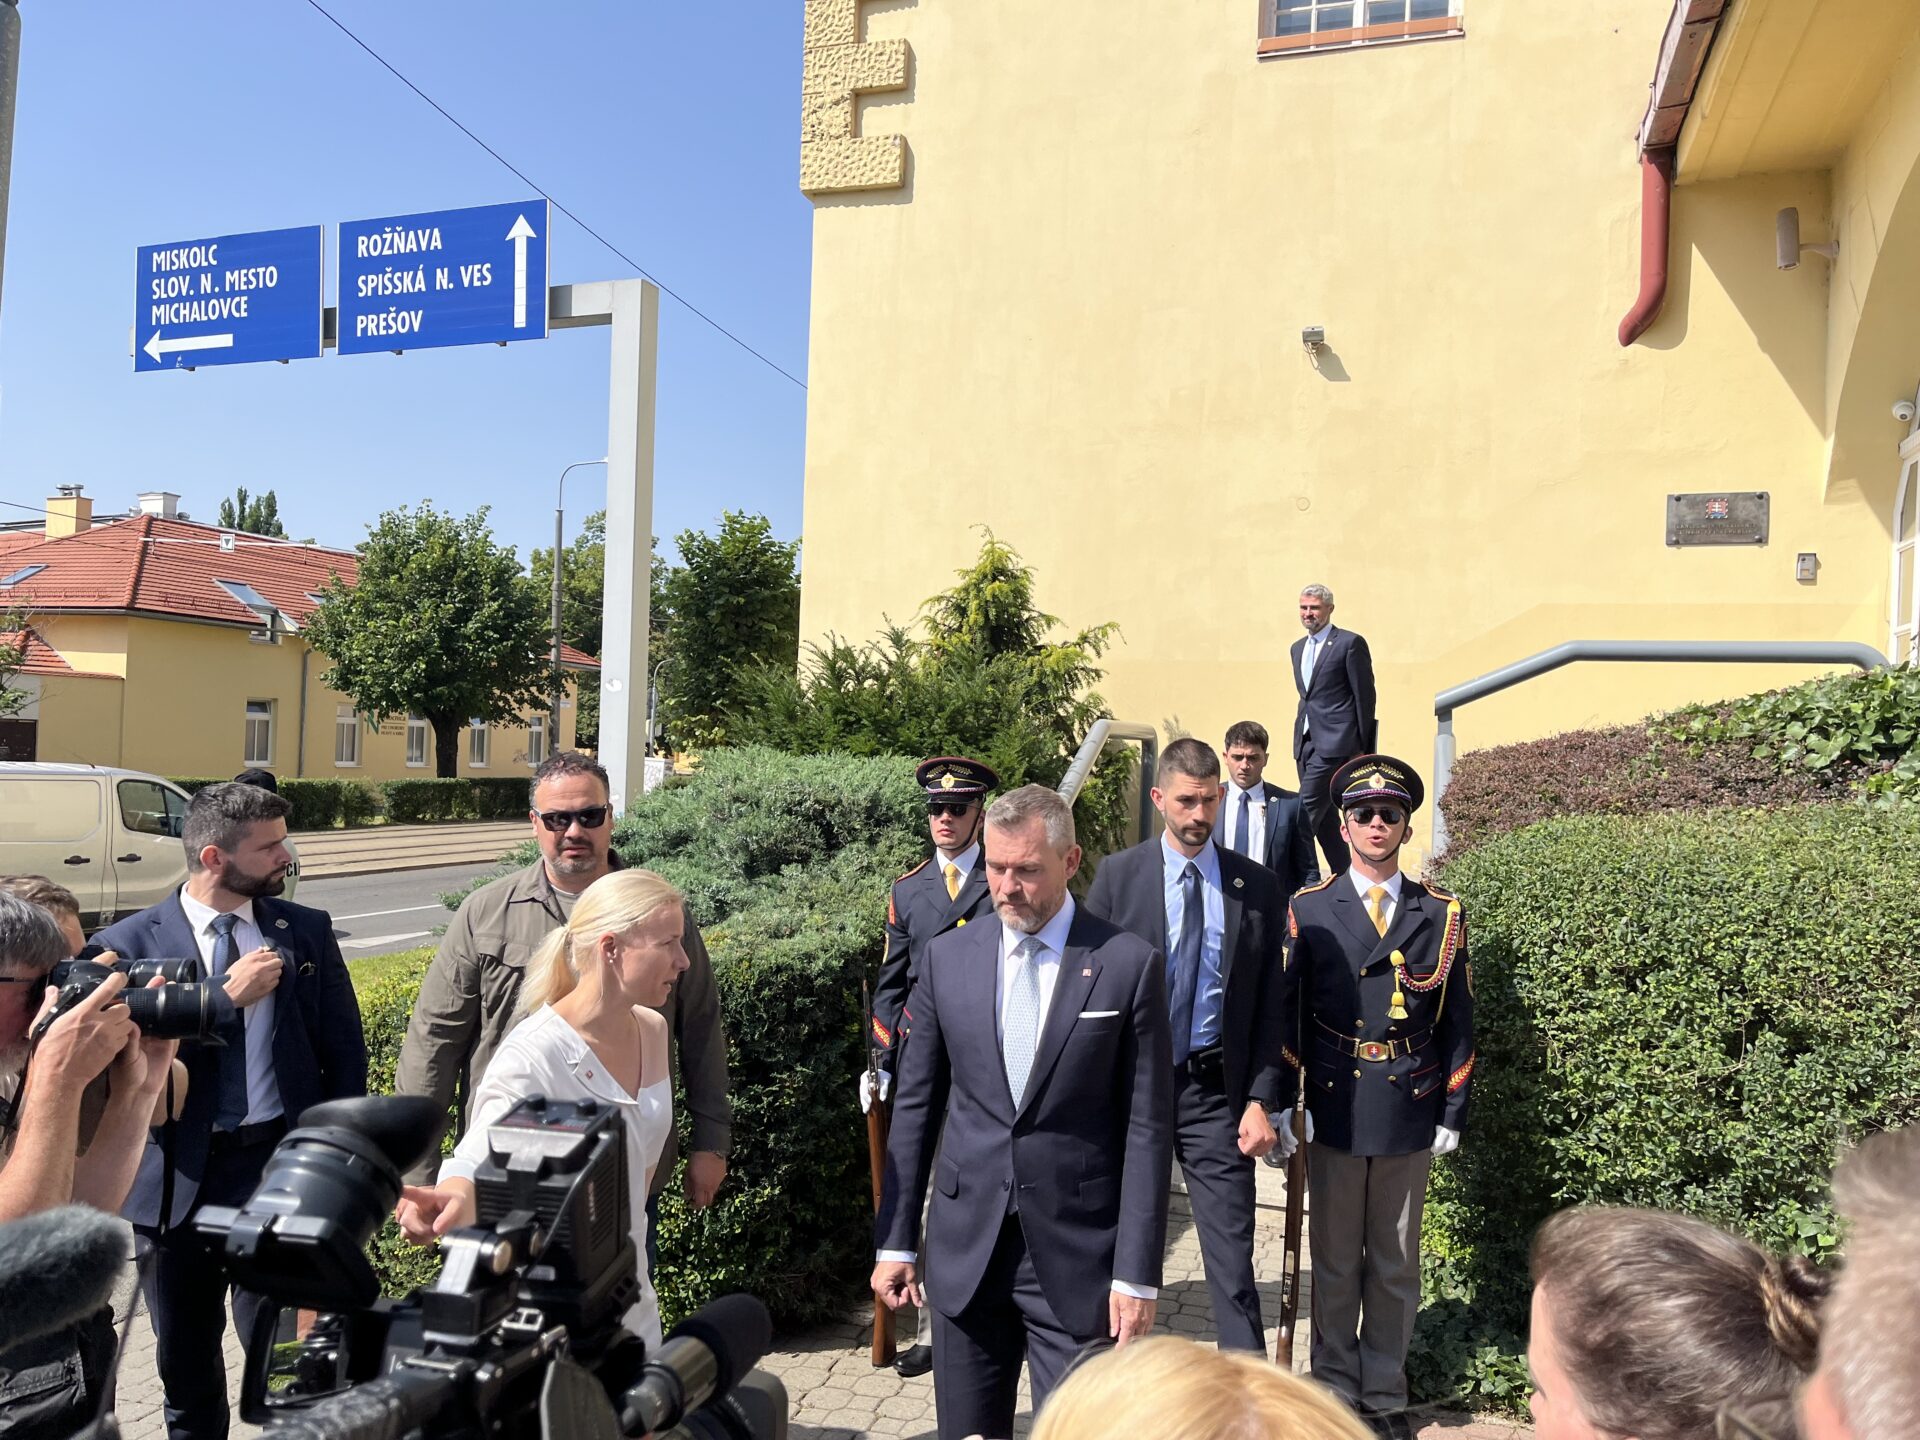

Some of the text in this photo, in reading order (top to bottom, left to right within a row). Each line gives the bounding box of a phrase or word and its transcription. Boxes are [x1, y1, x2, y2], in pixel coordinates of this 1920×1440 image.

[357, 226, 443, 258] ROŽŇAVA
[152, 244, 218, 273] MISKOLC
[151, 265, 278, 300] SLOV. N. MESTO
[357, 262, 492, 298] SPIŠSKÁ N. VES
[151, 296, 248, 326] MICHALOVCE
[356, 306, 423, 337] PREŠOV
